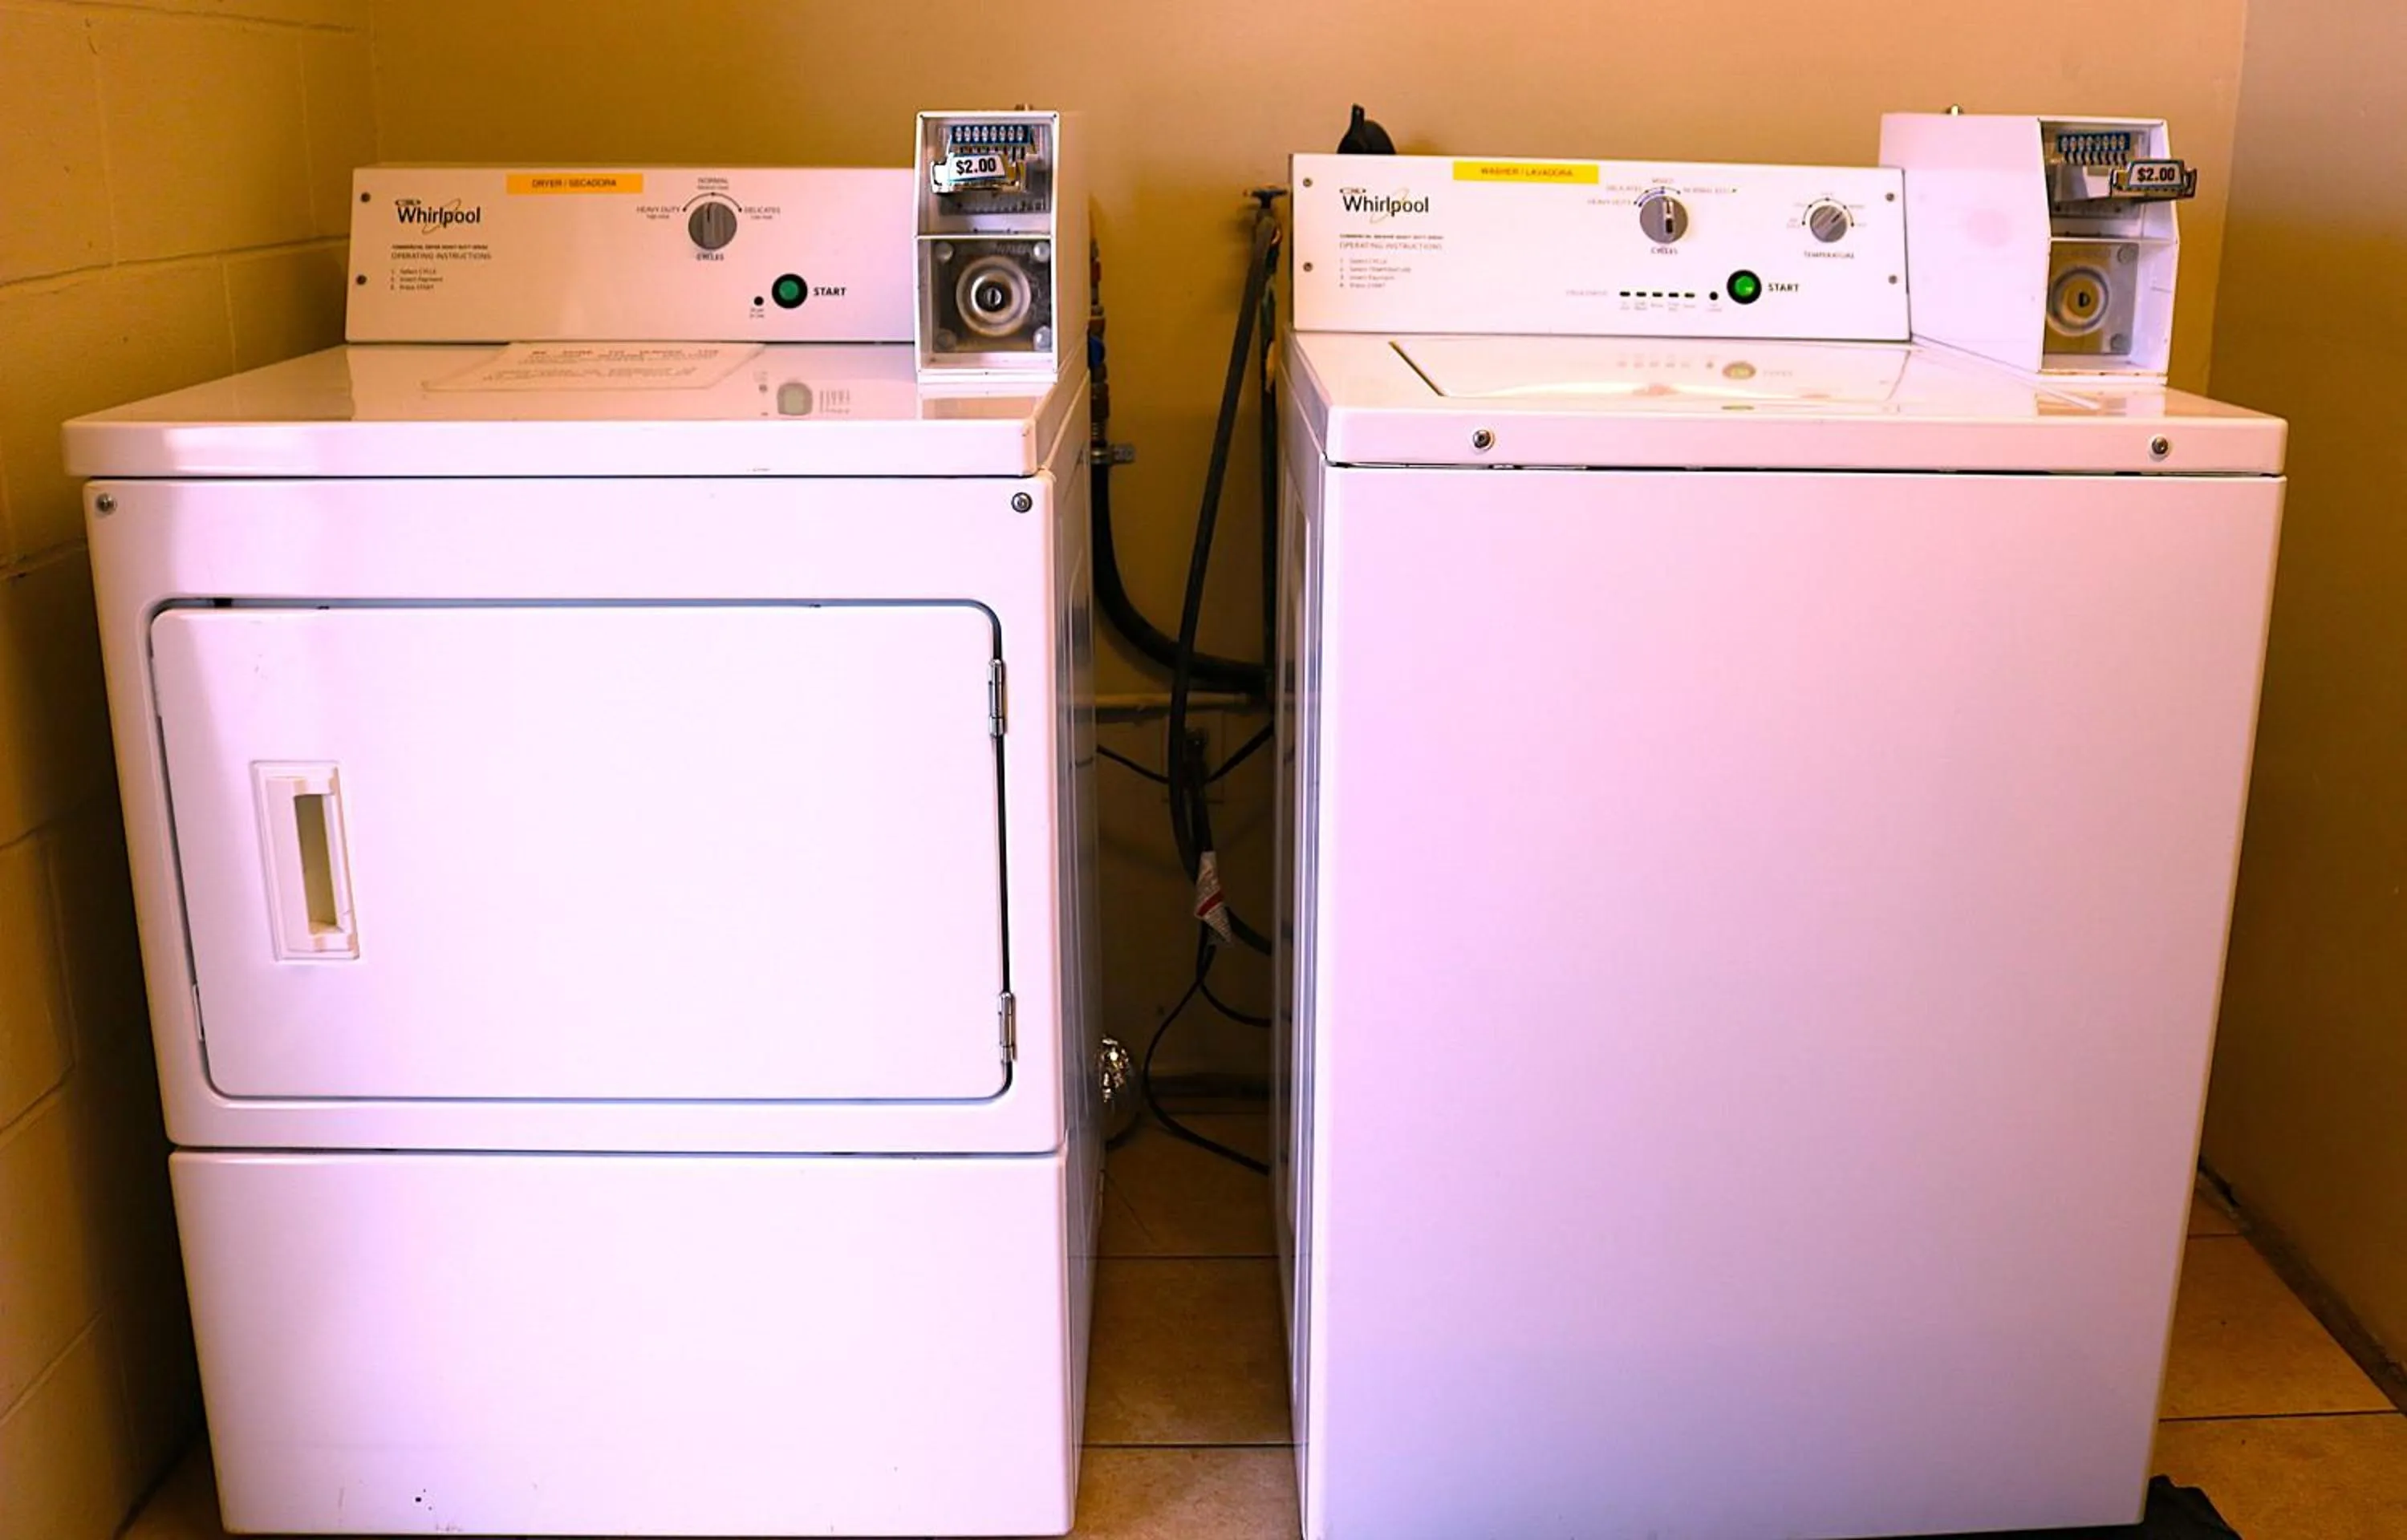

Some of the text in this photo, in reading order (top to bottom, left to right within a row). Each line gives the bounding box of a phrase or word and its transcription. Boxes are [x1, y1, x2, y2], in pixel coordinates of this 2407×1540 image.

[956, 158, 996, 175] $2.00
[1480, 167, 1519, 175] WASHER
[1526, 167, 1573, 176] LAVADORA
[2137, 167, 2175, 182] $2.00
[532, 179, 562, 188] DRYER
[569, 179, 616, 188] SECADORA
[1342, 195, 1429, 217] Whirlpool
[397, 206, 481, 229] Whirlpool
[1651, 247, 1678, 255] CYCLES
[696, 253, 725, 261] CYCLES
[813, 286, 846, 296] START
[1768, 283, 1800, 292] START
